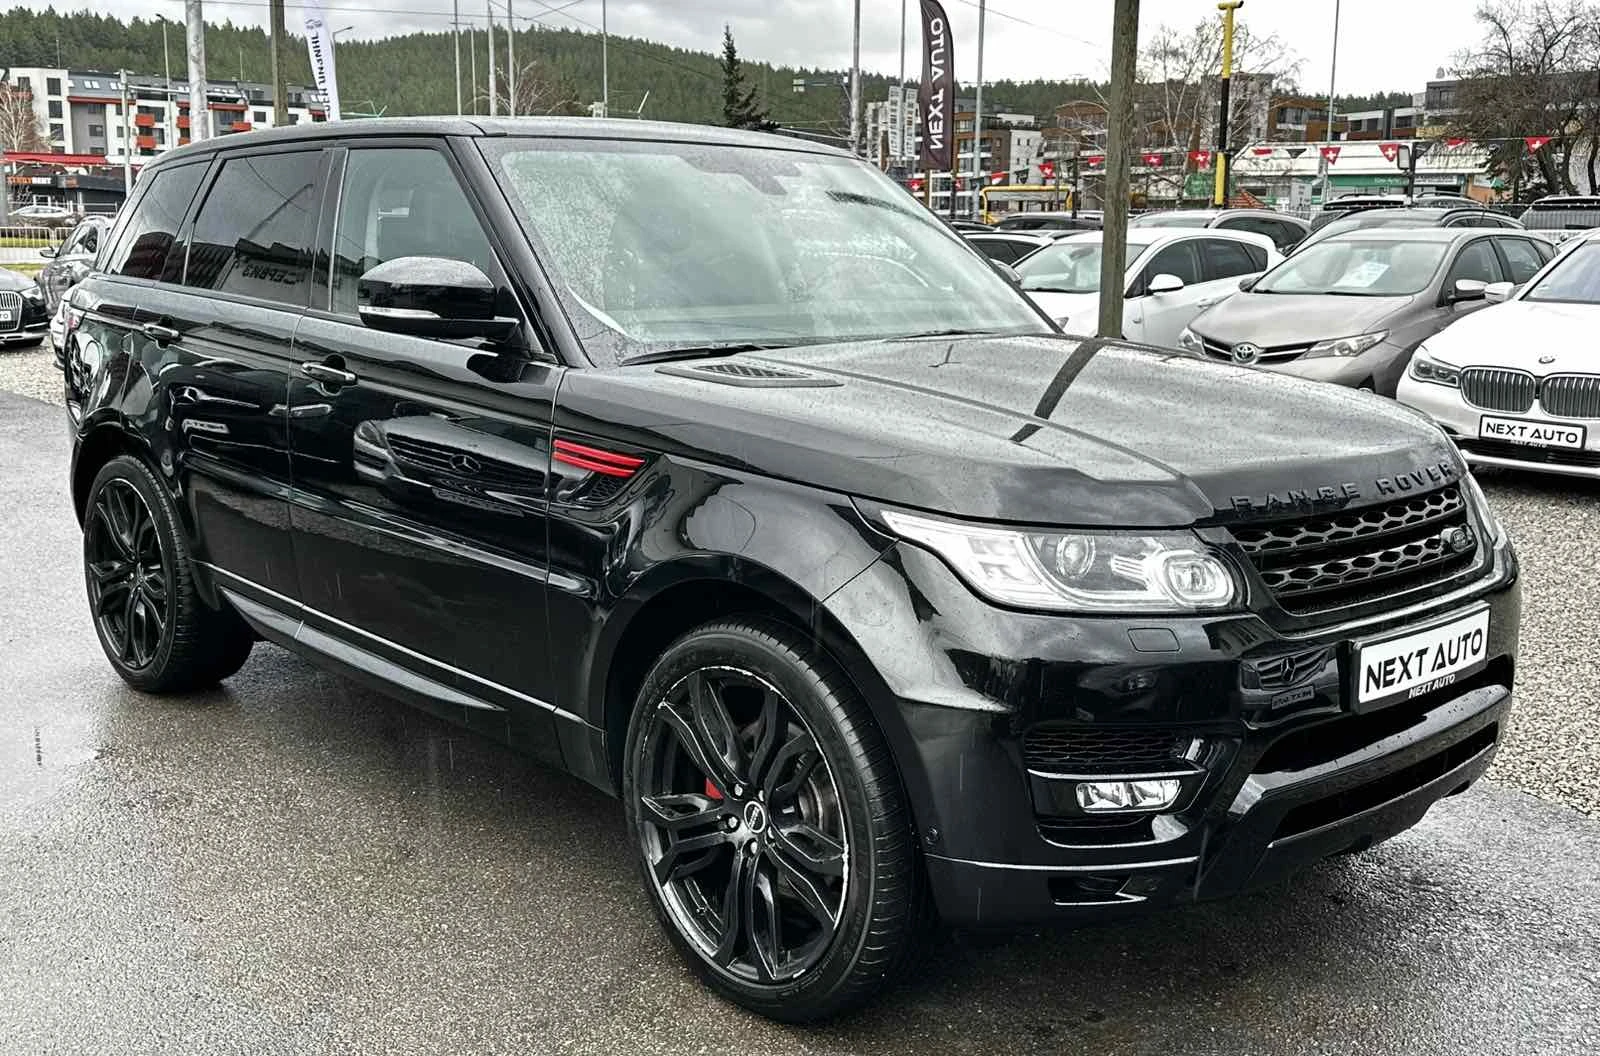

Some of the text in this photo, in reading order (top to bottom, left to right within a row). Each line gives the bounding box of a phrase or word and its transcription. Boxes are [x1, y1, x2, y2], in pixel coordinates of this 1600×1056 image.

[1486, 422, 1578, 443] NEXT AUTO
[1230, 461, 1456, 513] RANGE ROVER
[1365, 628, 1483, 693] NEXT AUTO
[1408, 673, 1456, 699] NEXT AUTO
